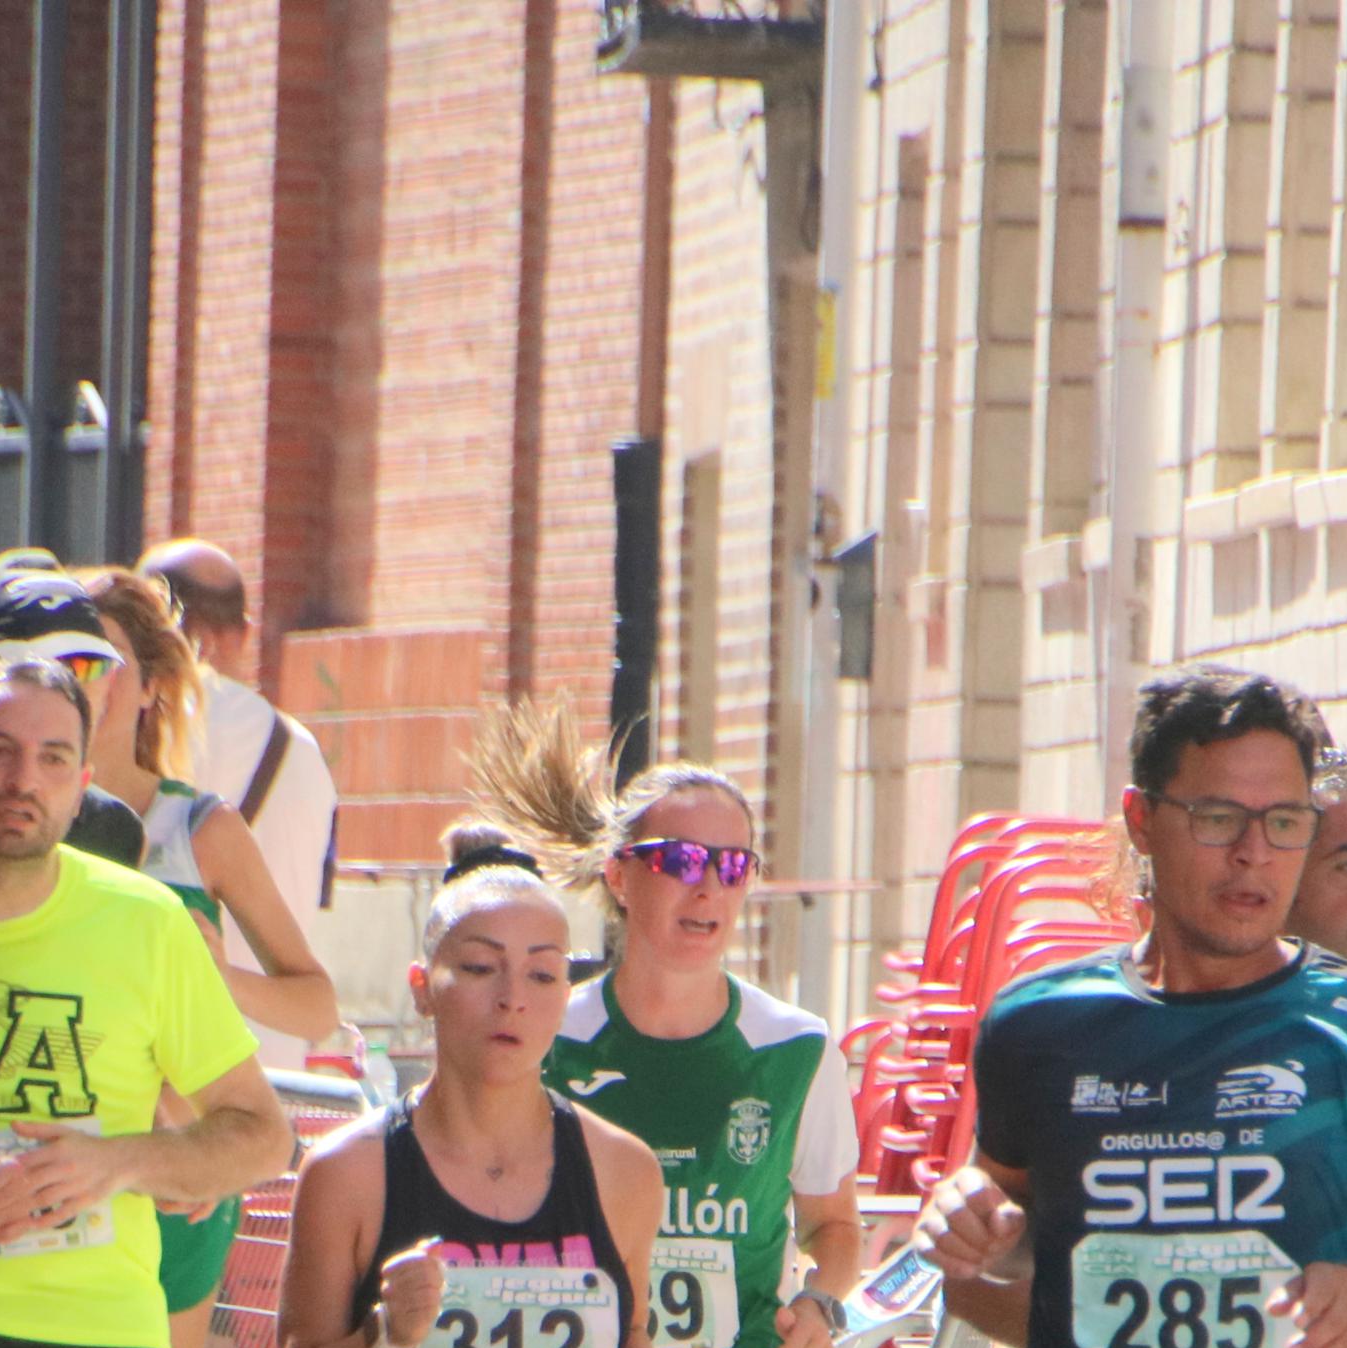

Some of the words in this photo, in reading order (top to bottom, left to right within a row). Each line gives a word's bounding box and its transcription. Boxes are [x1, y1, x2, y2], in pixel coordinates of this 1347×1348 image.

[1102, 1131, 1226, 1151] ORGULLOS@
[1239, 1128, 1264, 1146] DE
[1082, 1154, 1286, 1225] SER
